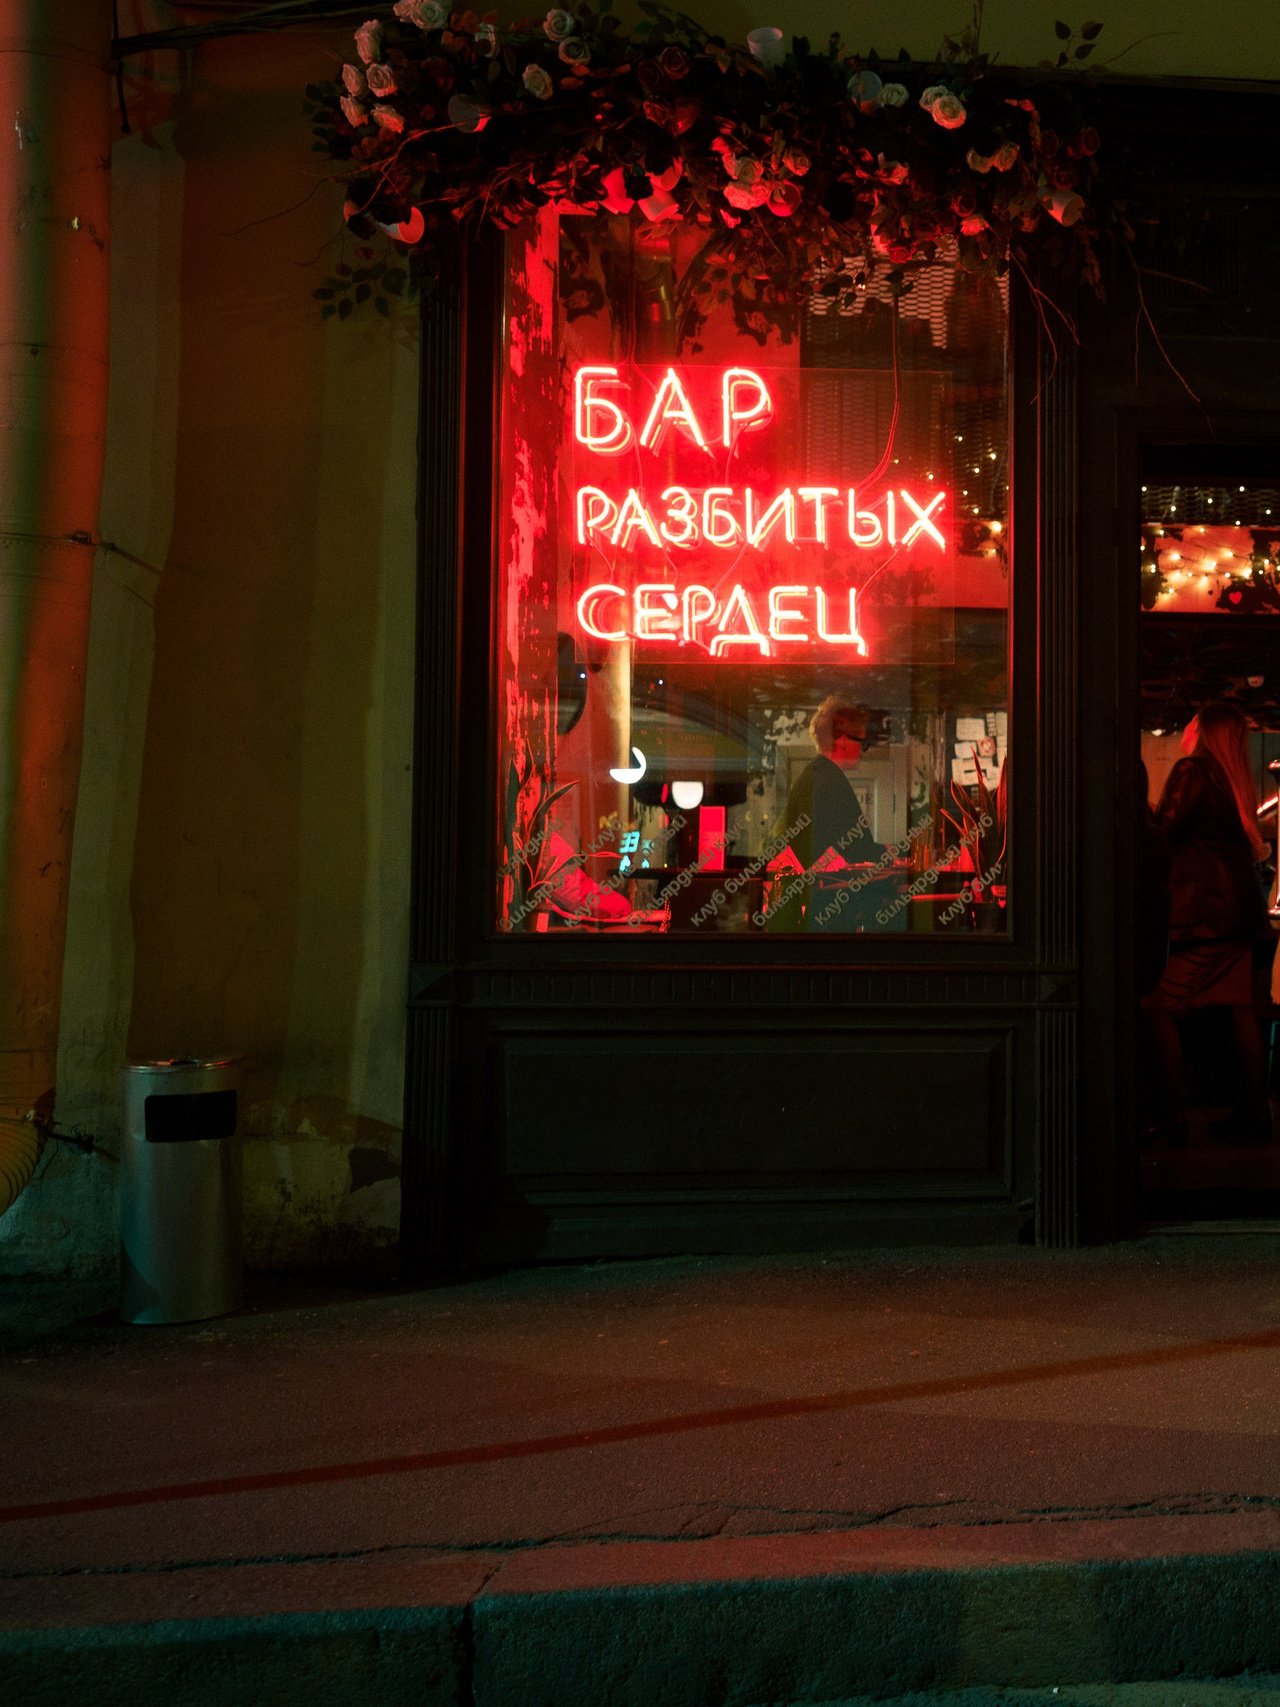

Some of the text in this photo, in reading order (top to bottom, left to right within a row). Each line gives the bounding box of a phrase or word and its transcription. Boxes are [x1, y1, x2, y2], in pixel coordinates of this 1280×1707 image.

[573, 366, 774, 458] БАР
[574, 485, 948, 552] РАЗБИТЫХ
[575, 583, 870, 658] СЕРДЕЦ
[588, 814, 623, 853] клуб
[690, 810, 812, 928] клуб бильярдный
[752, 813, 870, 927] бильярдный клуб
[814, 812, 935, 926] клуб бильярдный
[875, 811, 994, 926] бильярдный клуб
[564, 891, 600, 929] клуб
[626, 844, 716, 929] бильярдный
[938, 887, 974, 926] клуб
